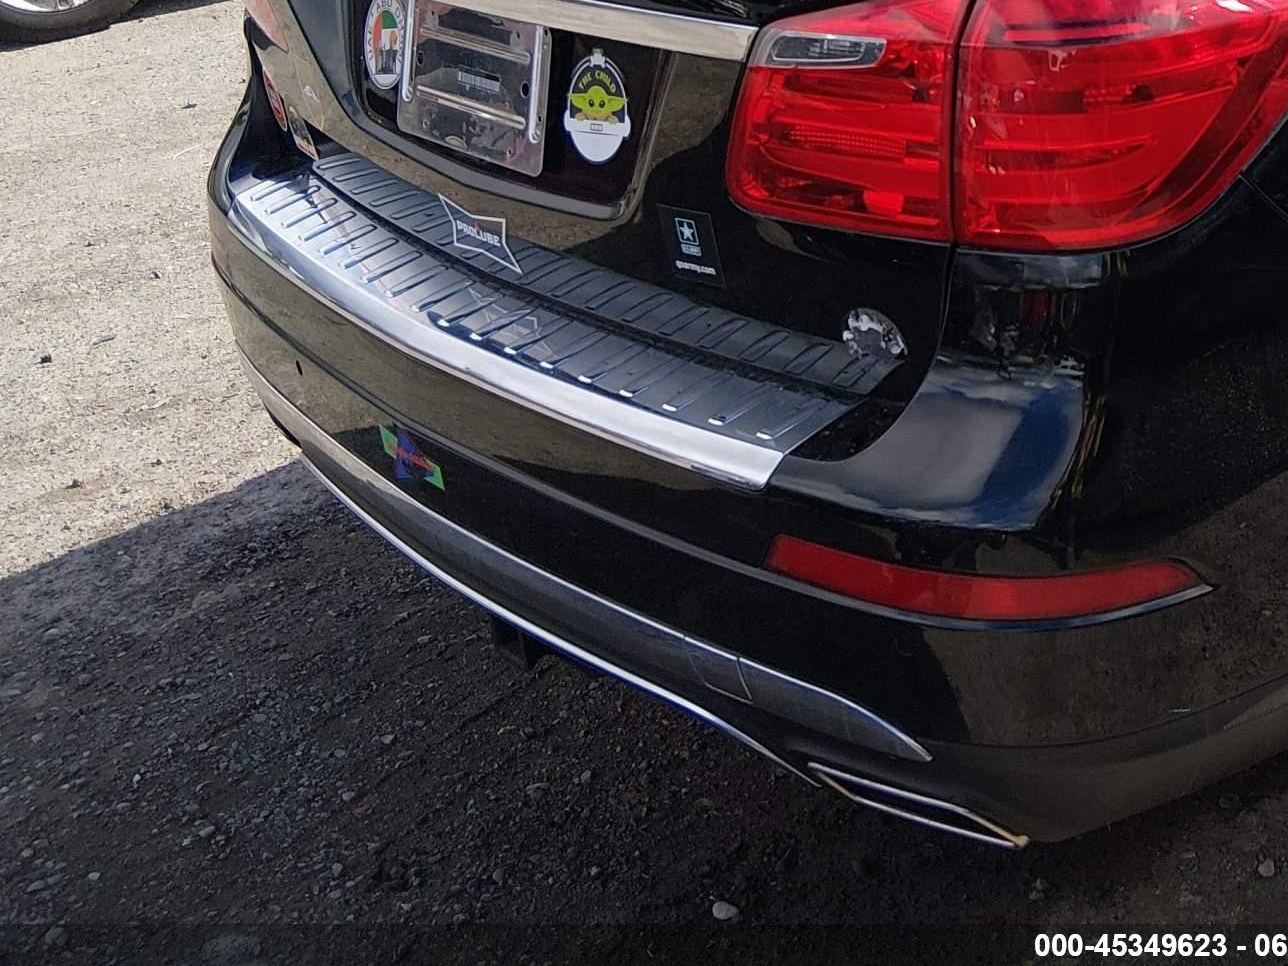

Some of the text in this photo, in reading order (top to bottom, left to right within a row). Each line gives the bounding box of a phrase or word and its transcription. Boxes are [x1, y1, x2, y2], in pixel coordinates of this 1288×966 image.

[578, 70, 617, 93] THE CHILD
[456, 219, 501, 247] PROLUBE
